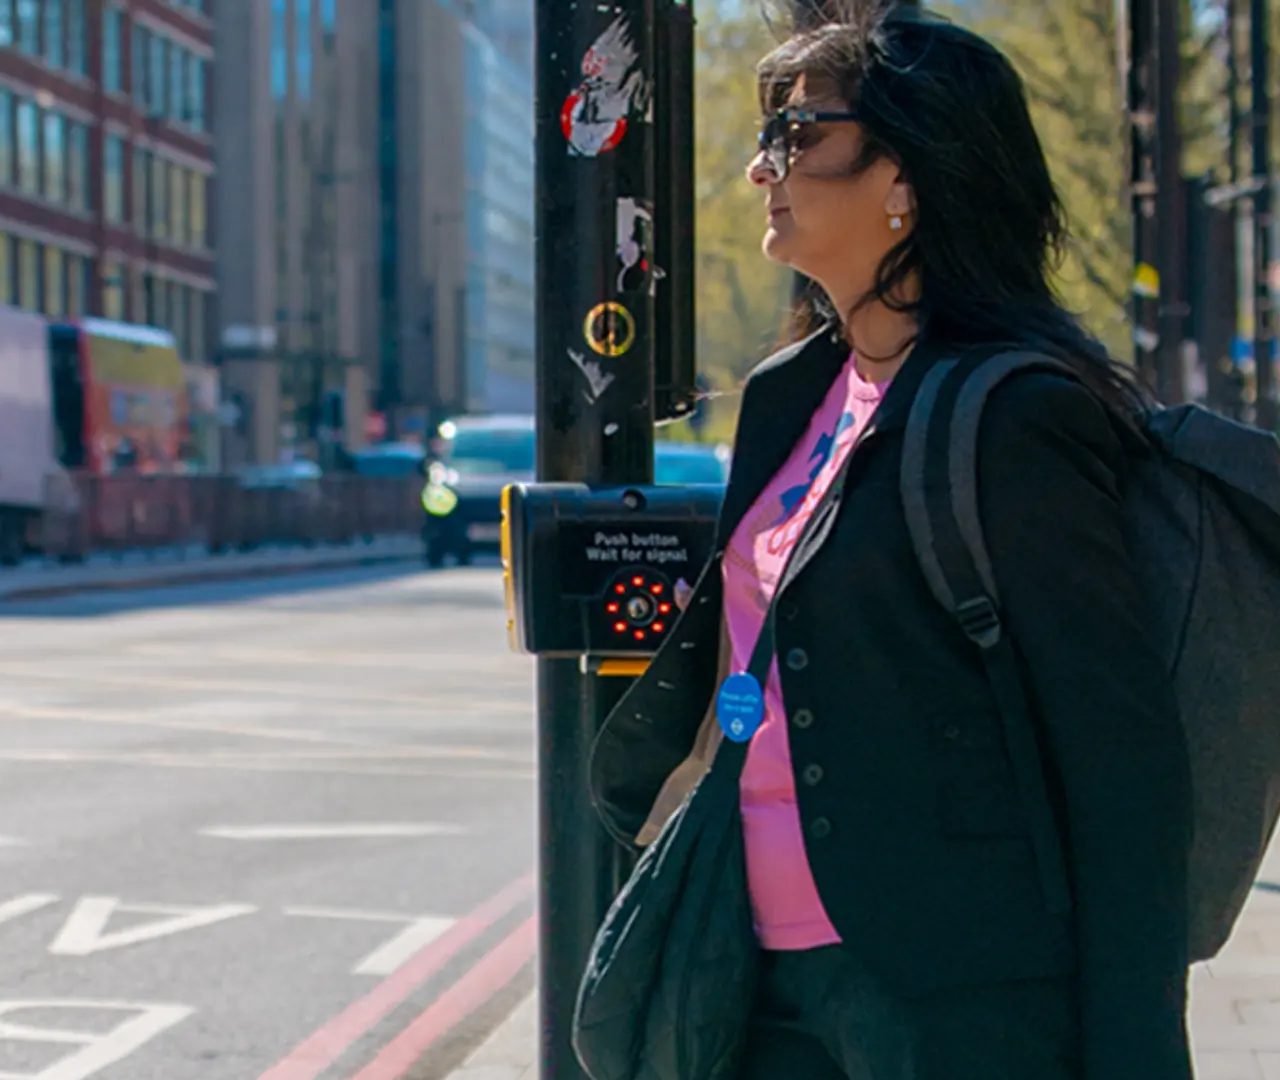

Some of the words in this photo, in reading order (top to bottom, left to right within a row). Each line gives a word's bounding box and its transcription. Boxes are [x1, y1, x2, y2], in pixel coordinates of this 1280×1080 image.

[594, 531, 629, 546] Push
[632, 531, 679, 546] button
[586, 547, 619, 561] Wait
[621, 547, 643, 561] for
[646, 547, 688, 563] signal
